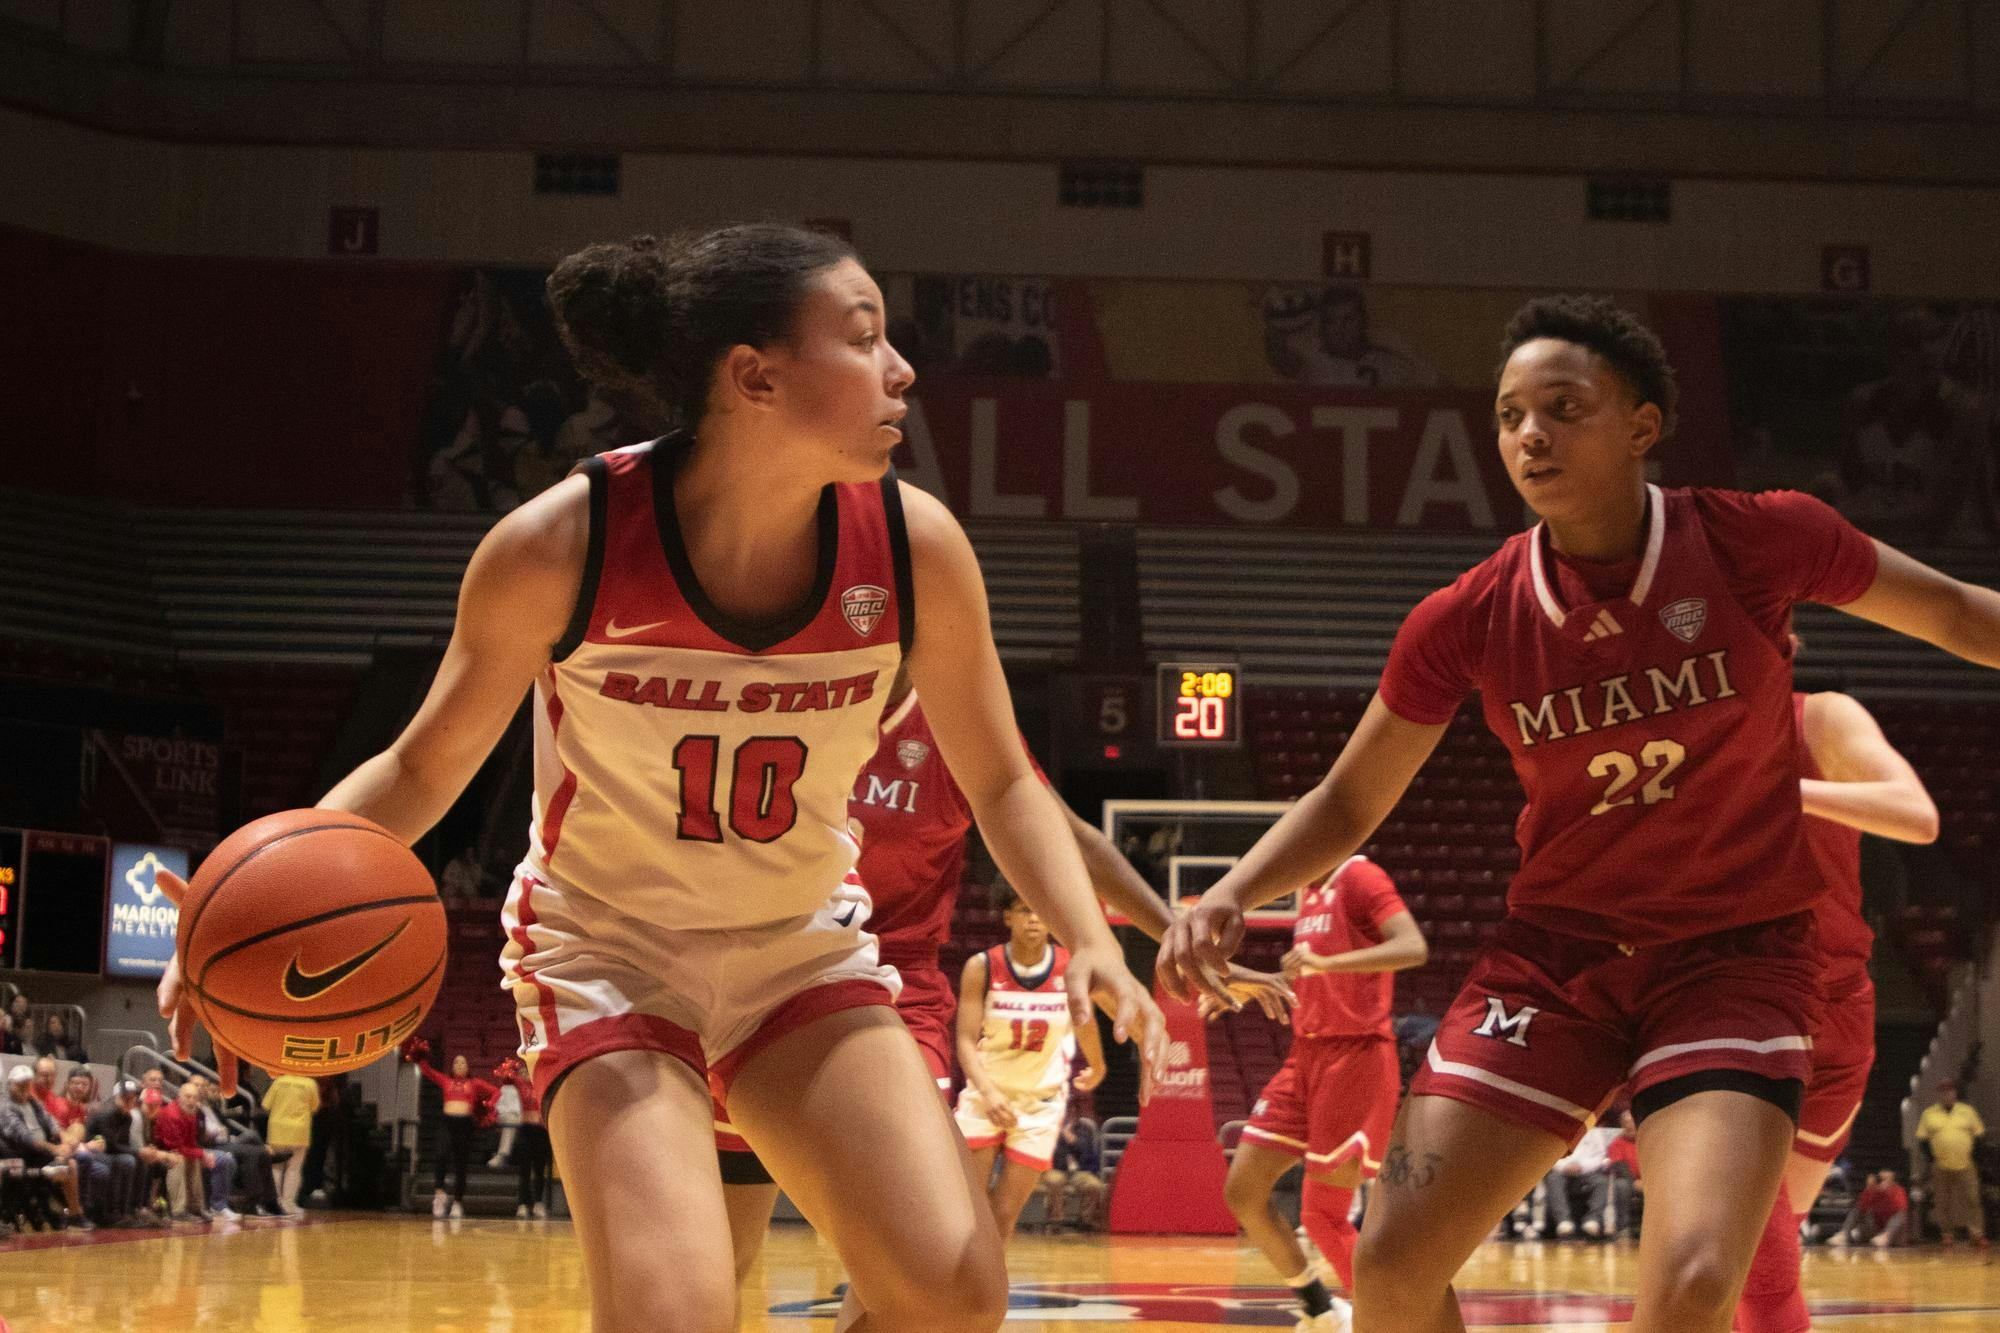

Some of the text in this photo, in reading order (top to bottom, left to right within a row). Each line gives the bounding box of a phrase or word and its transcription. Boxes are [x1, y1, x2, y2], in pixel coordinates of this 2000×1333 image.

[343, 220, 365, 251] J
[1332, 240, 1361, 273] H
[1831, 256, 1860, 289] G
[893, 399, 1535, 530] ALL STA
[845, 600, 884, 617] MAC
[599, 670, 879, 713] BALL STATE
[1180, 672, 1233, 698] 2:08
[1511, 651, 1738, 746] MIAMI
[1102, 696, 1126, 733] 5
[1175, 696, 1225, 739] 20
[123, 734, 220, 769] SPORTS
[155, 768, 217, 796] LINK
[672, 734, 809, 843] 10
[1587, 738, 1686, 817] 22
[113, 904, 179, 924] MARION
[282, 1003, 420, 1061] ELITE
[1008, 1018, 1049, 1052] 12
[1473, 996, 1540, 1048] M
[1161, 1067, 1207, 1086] uoff
